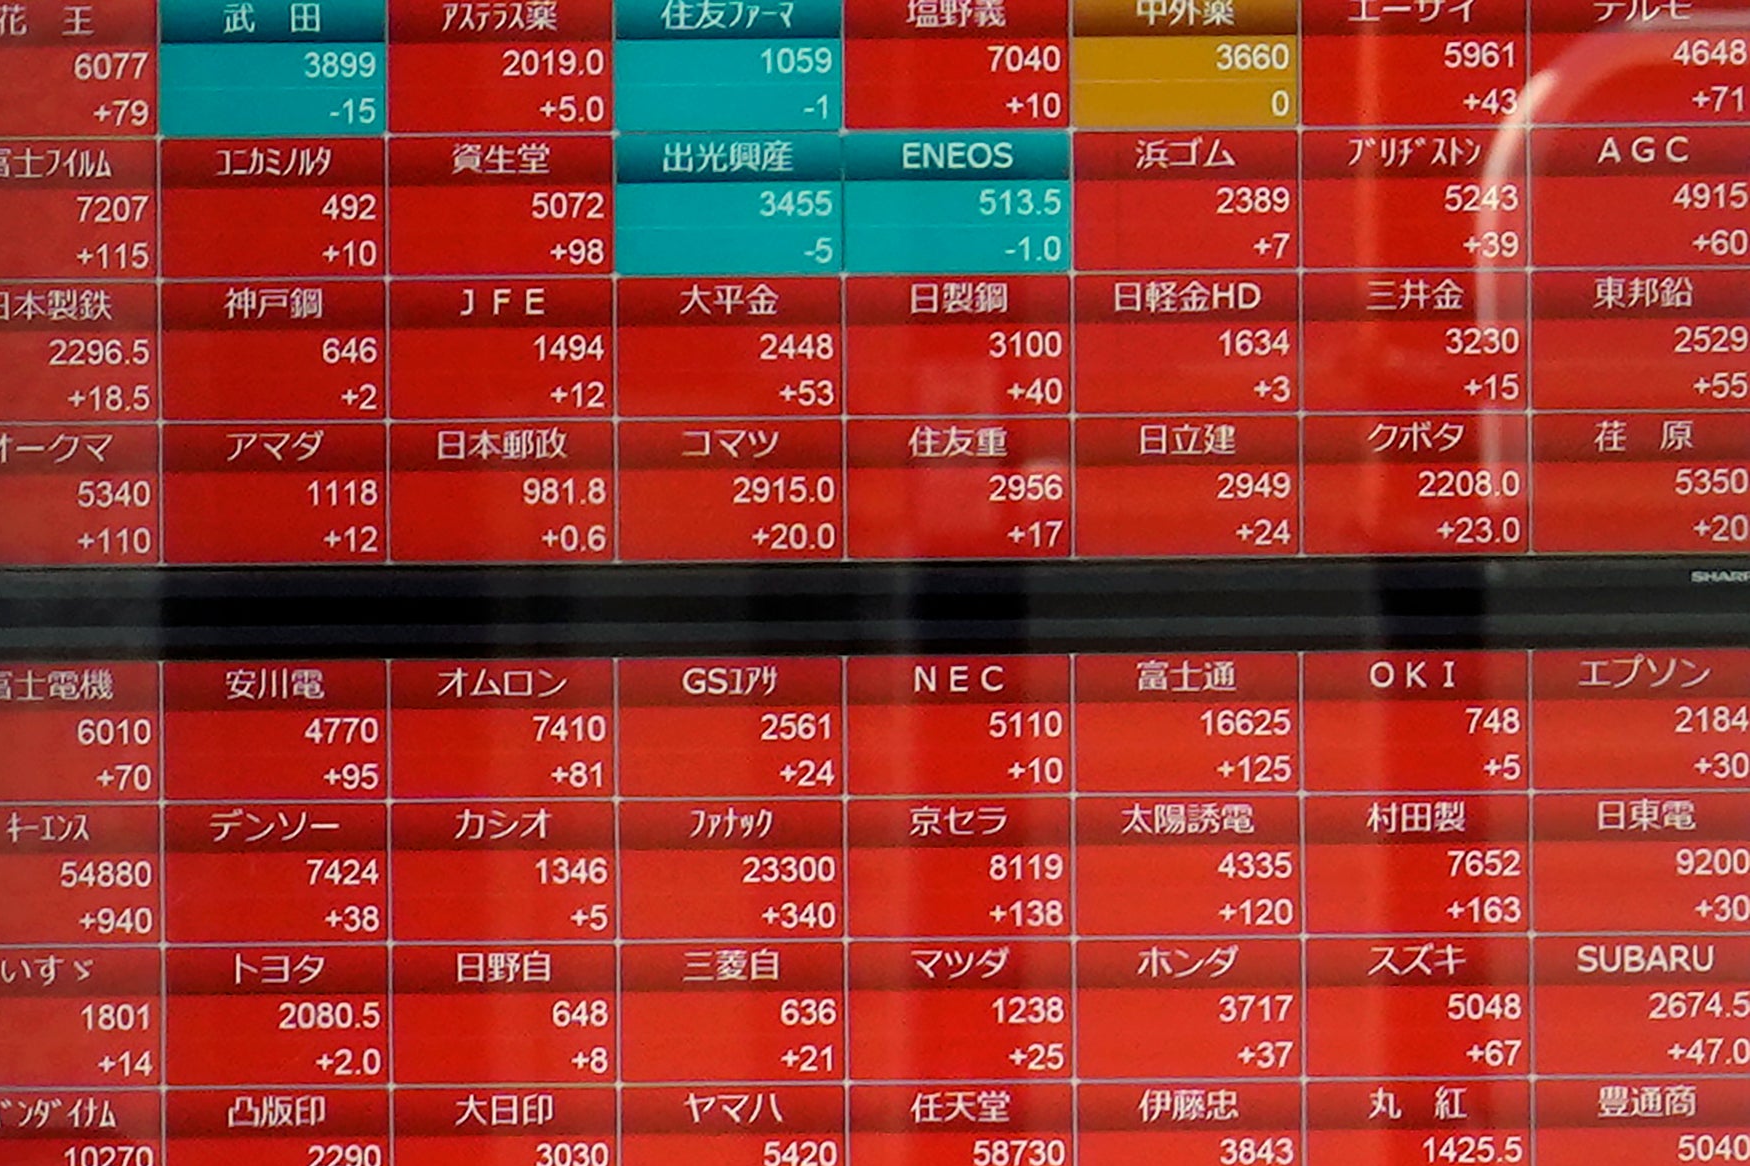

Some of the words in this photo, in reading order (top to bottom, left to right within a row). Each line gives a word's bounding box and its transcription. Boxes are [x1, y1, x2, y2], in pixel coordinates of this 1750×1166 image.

[451, 141, 551, 175] 資生堂
[661, 138, 794, 174] 出光興産
[901, 140, 1015, 170] ENEOS
[1134, 136, 1237, 170] 浜ゴム
[531, 190, 606, 221] 5072
[758, 188, 834, 218] 3455
[978, 187, 1062, 217] 513.5
[1215, 185, 1291, 215] 2389
[549, 235, 605, 266] +98
[802, 236, 834, 265] -5
[1004, 234, 1063, 263] -1.0
[1252, 231, 1292, 260] +7
[223, 286, 324, 320] 神戸鋼
[48, 337, 151, 366] 2296.5
[321, 336, 379, 365] 646
[1217, 327, 1291, 358] 1634
[66, 383, 151, 413] +18.5
[340, 382, 378, 411] +2
[1252, 374, 1292, 404] +3
[683, 428, 780, 459] コマツ
[1366, 419, 1465, 453] クボタ
[732, 474, 836, 505] 2915.0
[1417, 469, 1521, 498] 2208.0
[750, 521, 836, 551] +20.0
[1435, 515, 1521, 545] +23.0
[436, 666, 568, 699] オムロン
[1135, 658, 1238, 693] 富士通
[531, 714, 607, 743] 7410
[1199, 707, 1292, 737] 16625
[550, 760, 603, 789] +81
[1216, 754, 1293, 784] +125
[1120, 801, 1256, 836] 太陽誘電
[1366, 800, 1466, 834] 村田製
[1216, 850, 1294, 880] 4335
[1446, 848, 1522, 878] 7652
[1217, 897, 1294, 926] +120
[1445, 895, 1523, 924] +163
[234, 952, 326, 986] トヨタ
[1576, 943, 1715, 974] SUBARU
[278, 1000, 382, 1031] 2080.5
[1648, 989, 1750, 1020] 2674.5
[314, 1047, 382, 1077] +2.0
[1666, 1036, 1750, 1066] +47.0
[909, 1089, 1012, 1124] 任天堂
